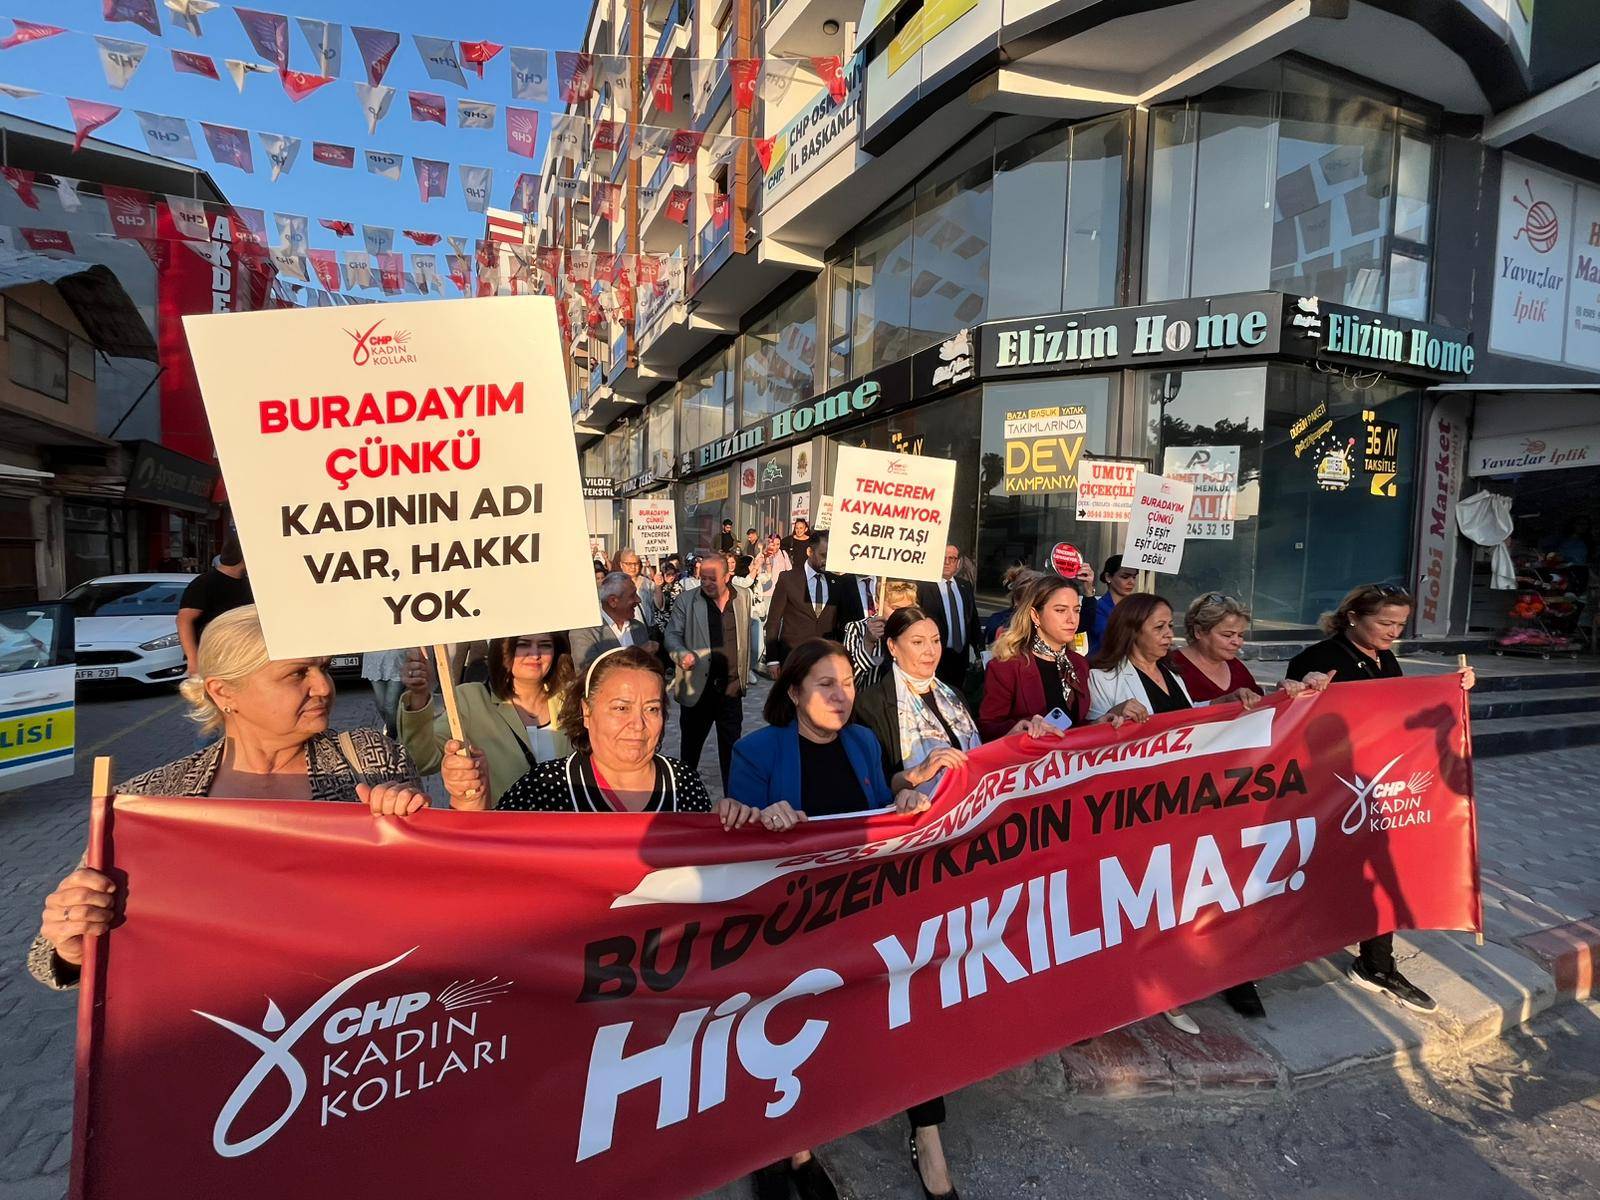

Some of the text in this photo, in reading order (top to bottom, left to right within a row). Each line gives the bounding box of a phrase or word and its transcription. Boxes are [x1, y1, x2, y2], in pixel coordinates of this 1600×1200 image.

[767, 166, 785, 190] CHP
[1501, 256, 1563, 291] Yavuzlar
[369, 335, 393, 346] CHP
[370, 345, 407, 355] KADIN
[996, 320, 1119, 368] Elizim
[1132, 310, 1268, 355] Home
[1327, 313, 1404, 362] Elizim
[1409, 328, 1475, 375] Home
[372, 354, 417, 366] KOLLARI
[258, 381, 525, 434] BURADAYIM
[1061, 406, 1084, 415] YATAK
[700, 380, 881, 467] Elizim Home
[1008, 419, 1084, 435] TAKIMLARINDA
[325, 428, 482, 491] ÇÜNKÜ
[1006, 436, 1084, 474] DEV
[1481, 453, 1546, 470] Yavuzlar
[584, 478, 612, 487] YILDIZ
[1092, 465, 1135, 480] UMUT
[583, 487, 614, 496] TEKSTİL
[856, 478, 936, 501] TENCEREM
[280, 482, 544, 538] KADININ ADI
[840, 498, 942, 526] KAYNAMIYOR,
[1141, 495, 1185, 513] BURADAYIM
[1147, 511, 1175, 526] ÇÜNKÜ
[1186, 523, 1230, 536] 245 32 15
[1423, 417, 1451, 624] Hobi Market
[851, 521, 930, 547] SABIR TAŞI
[1154, 527, 1171, 540] EŞİT
[849, 544, 927, 565] ÇATLIYOR!
[1134, 538, 1177, 553] EŞİT ÜCRET
[303, 532, 541, 585] VAR, HAKKI
[383, 588, 482, 625] YOK.
[98, 669, 116, 678] 297
[1023, 727, 1193, 791] KAYNAMAZ,
[1372, 781, 1406, 798] CHP
[1370, 796, 1422, 815] KADIN
[1370, 810, 1432, 832] KOLLARI
[575, 921, 701, 1004] BU
[932, 799, 1072, 884] KADIN
[1083, 758, 1309, 836] YIKMAZSA
[575, 816, 1317, 1163] HİÇ YIKILMAZ!
[322, 991, 432, 1045] CHP
[322, 1011, 478, 1087] KADIN
[320, 1034, 508, 1127] KOLLARI
